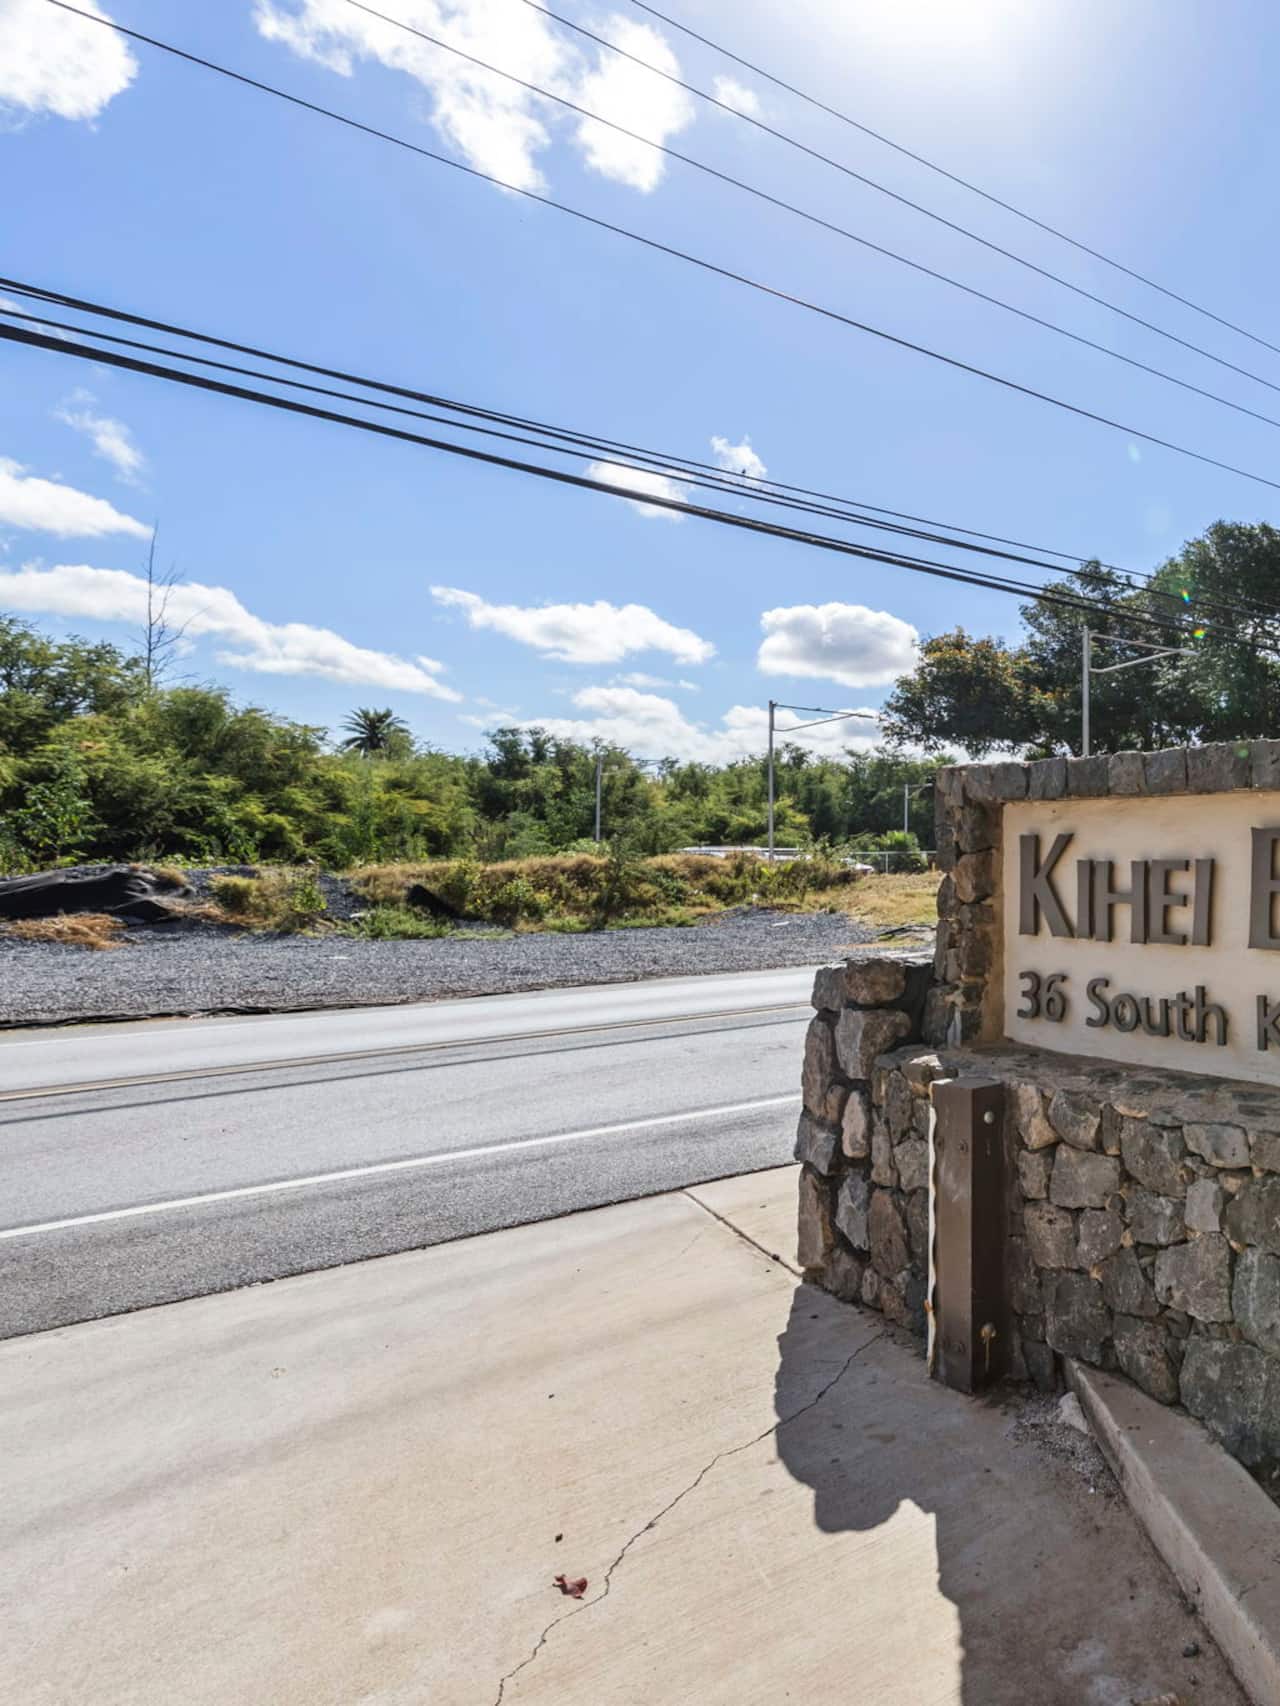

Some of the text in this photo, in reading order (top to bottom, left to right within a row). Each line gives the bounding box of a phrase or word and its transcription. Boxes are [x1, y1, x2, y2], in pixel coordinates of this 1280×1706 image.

[1018, 832, 1215, 946] KIHEI
[1016, 970, 1068, 1022] 36
[1086, 977, 1228, 1046] South
